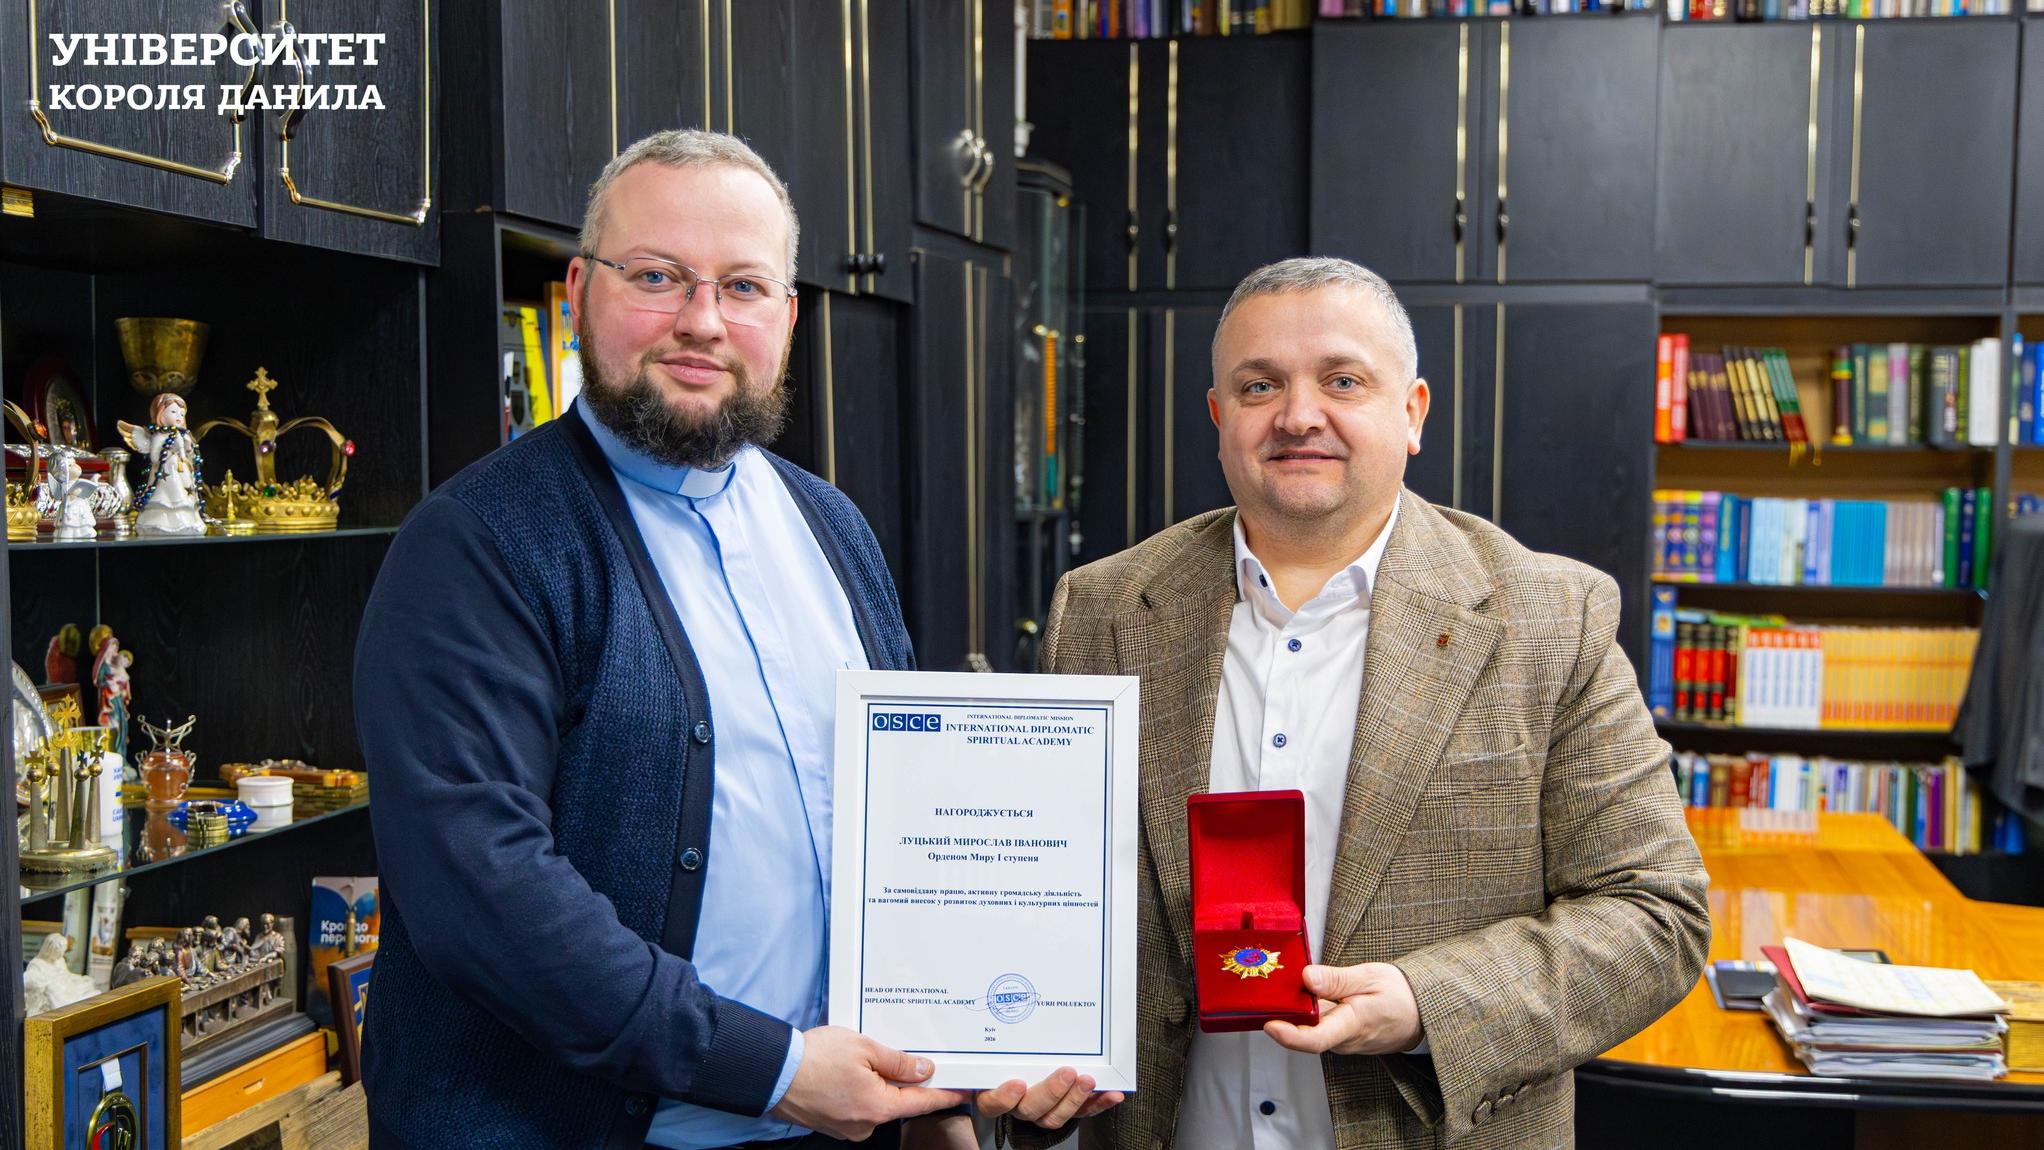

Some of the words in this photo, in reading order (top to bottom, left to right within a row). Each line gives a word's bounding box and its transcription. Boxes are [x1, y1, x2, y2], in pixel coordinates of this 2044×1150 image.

[946, 723, 1028, 733] INTERNATIONAL
[1031, 726, 1095, 734] DIPLOMATIC
[967, 736, 1020, 745] SPIRITUAL
[1021, 738, 1072, 746] ACADEMY
[935, 808, 1034, 818] НАГОРОДЖУЄТЬСЯ
[899, 837, 951, 847] ЛУЦЬКИЙ
[953, 838, 1012, 847] МИРОСЛАВ
[1014, 839, 1068, 848] ІВАНОВИЧ
[928, 852, 968, 863] Орденом
[970, 854, 995, 863] Миру
[893, 887, 938, 896] самовіддану
[1000, 890, 1042, 898] громадську
[1062, 900, 1099, 908] цінностей
